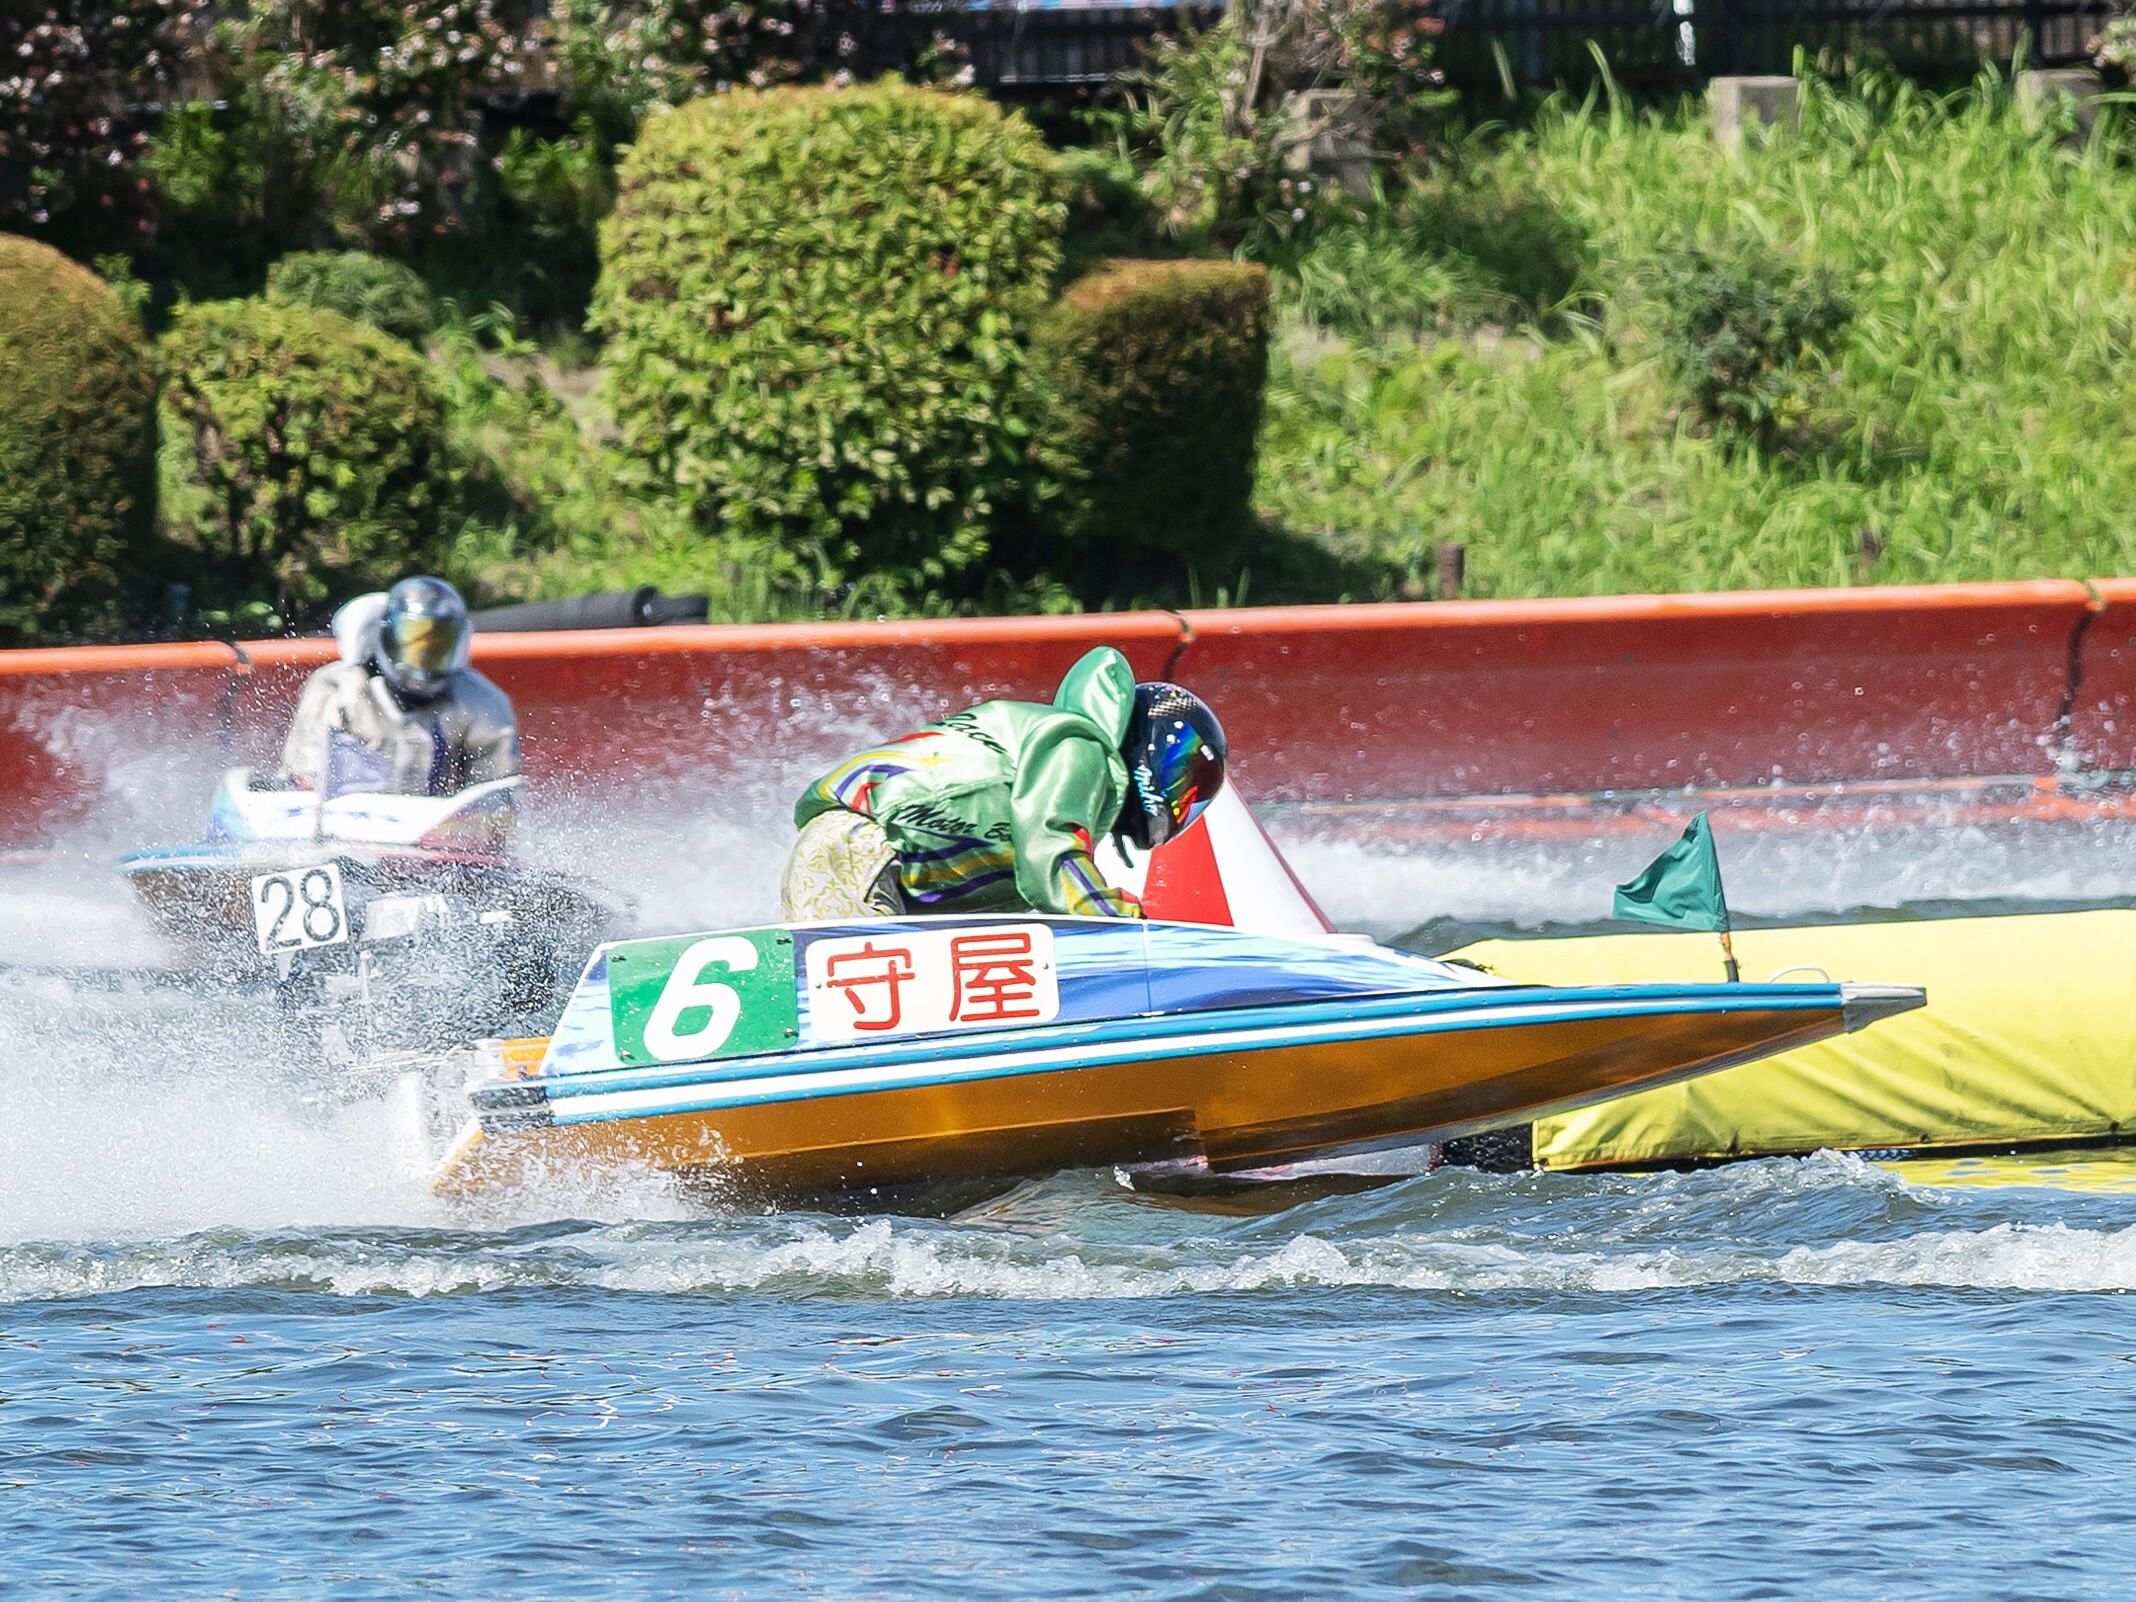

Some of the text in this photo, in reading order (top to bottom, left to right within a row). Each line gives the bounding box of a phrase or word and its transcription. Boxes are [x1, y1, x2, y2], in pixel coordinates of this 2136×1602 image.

[898, 803, 978, 834] Motor
[261, 868, 340, 951] 28
[643, 936, 759, 1062] 6
[826, 932, 1041, 1031] 守屋
